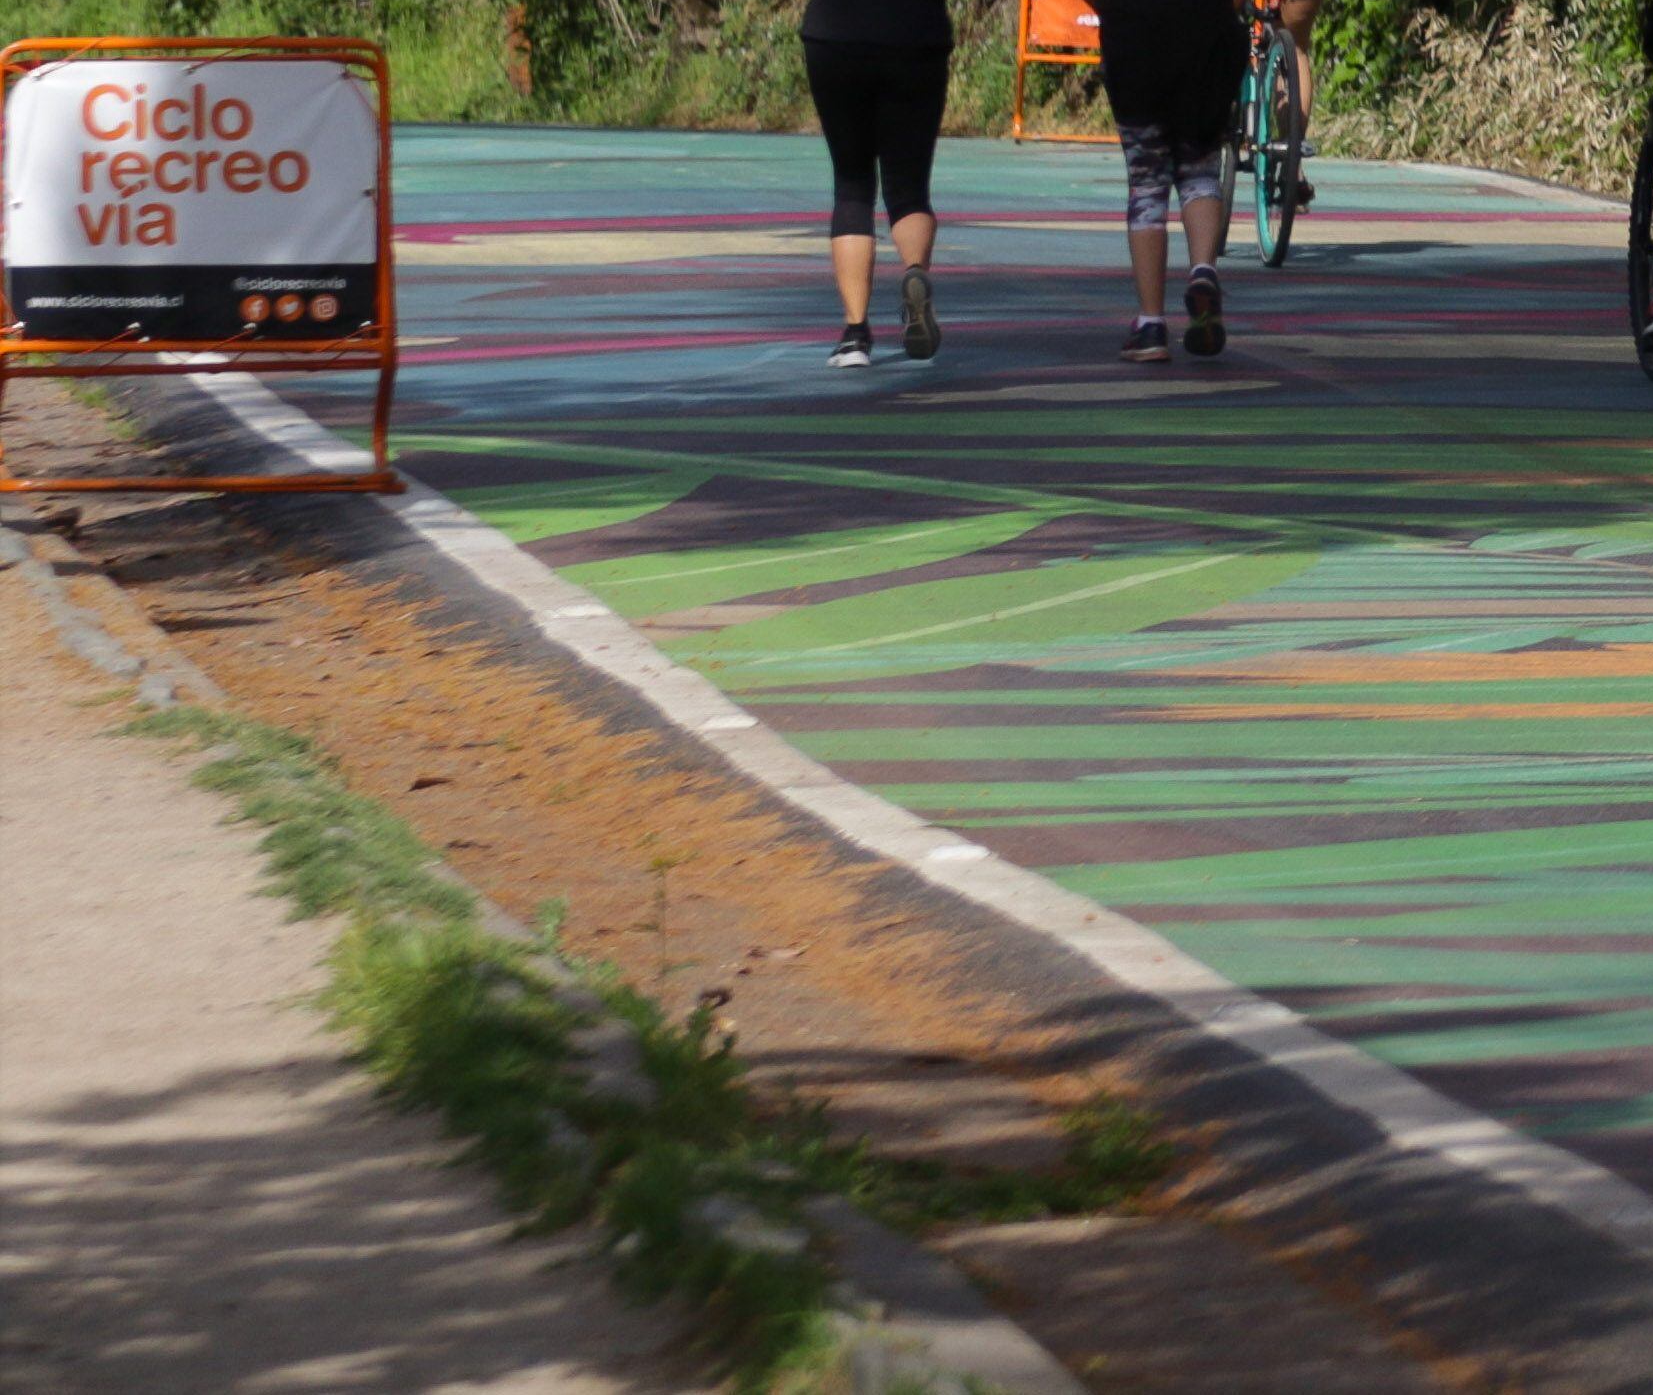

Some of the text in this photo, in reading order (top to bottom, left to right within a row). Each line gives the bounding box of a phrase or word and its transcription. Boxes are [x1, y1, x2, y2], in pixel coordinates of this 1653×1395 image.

[81, 82, 254, 142] Ciclo
[79, 148, 311, 194] recreo
[76, 183, 176, 246] vía
